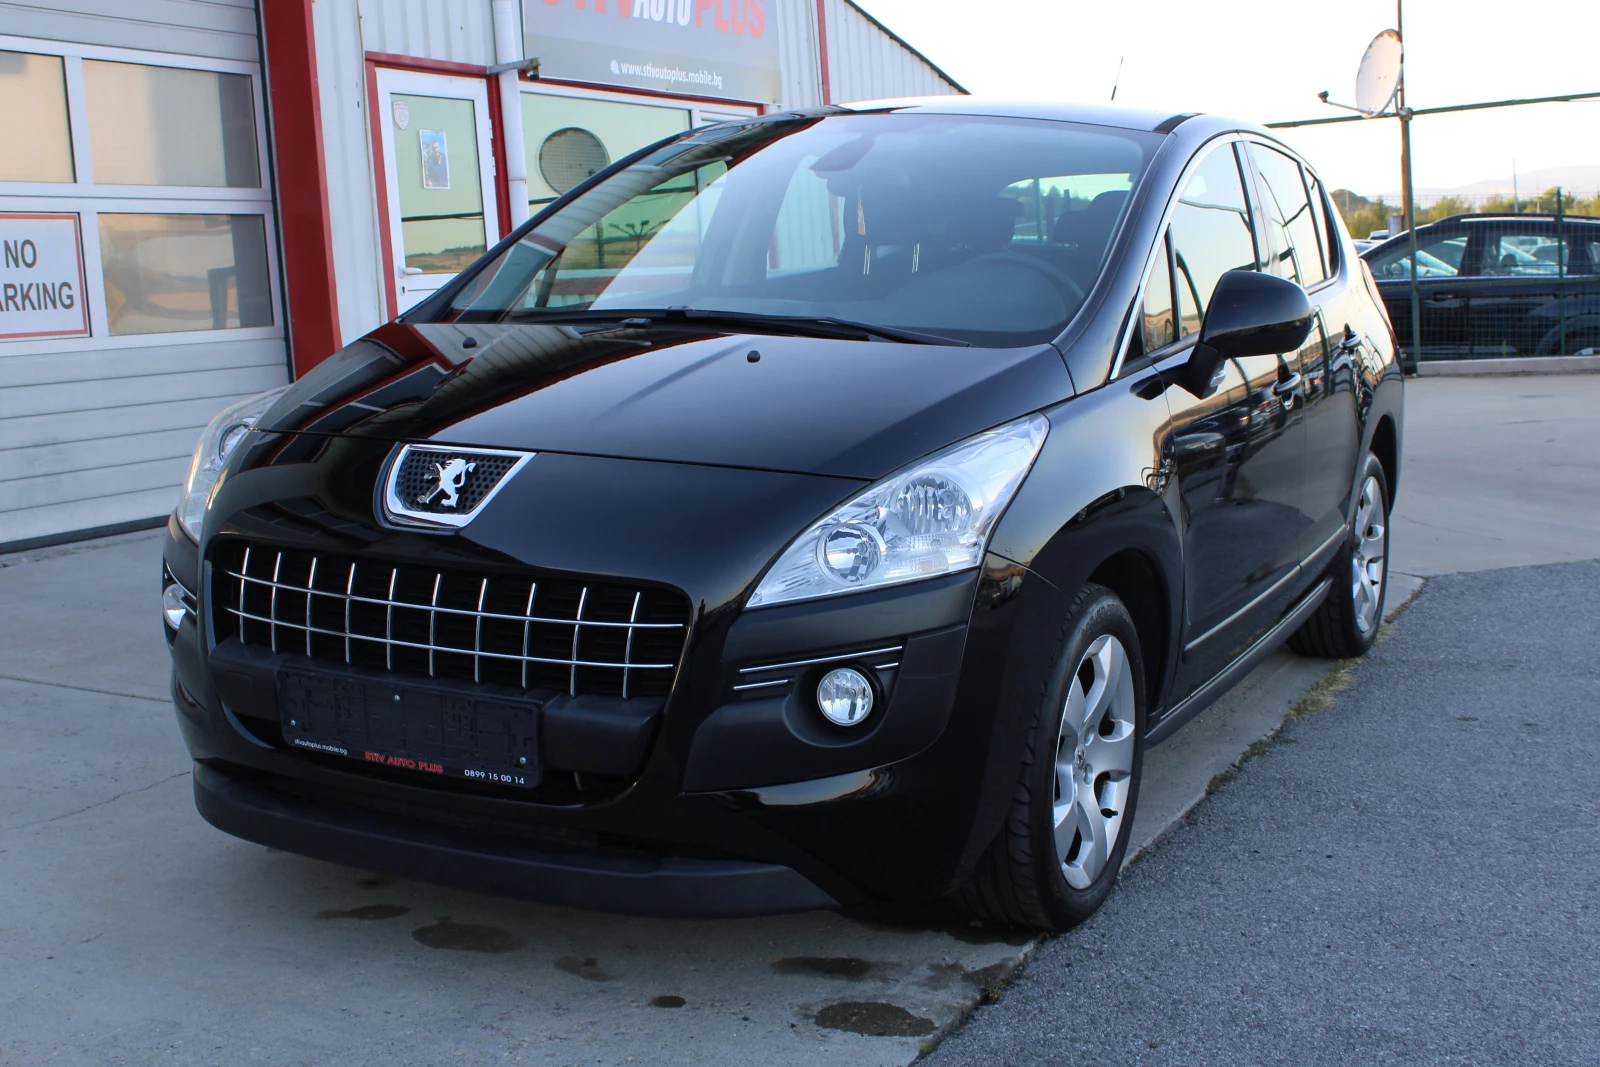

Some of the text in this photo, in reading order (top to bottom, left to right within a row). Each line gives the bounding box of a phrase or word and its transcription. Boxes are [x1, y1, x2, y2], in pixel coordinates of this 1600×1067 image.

[620, 61, 723, 89] www.stivautoplus.mobile.bg
[4, 239, 37, 269] NO
[0, 281, 75, 312] RKING
[387, 756, 416, 769] AUTO
[418, 760, 444, 774] PLUS
[464, 769, 525, 785] 0899 15 00 14
